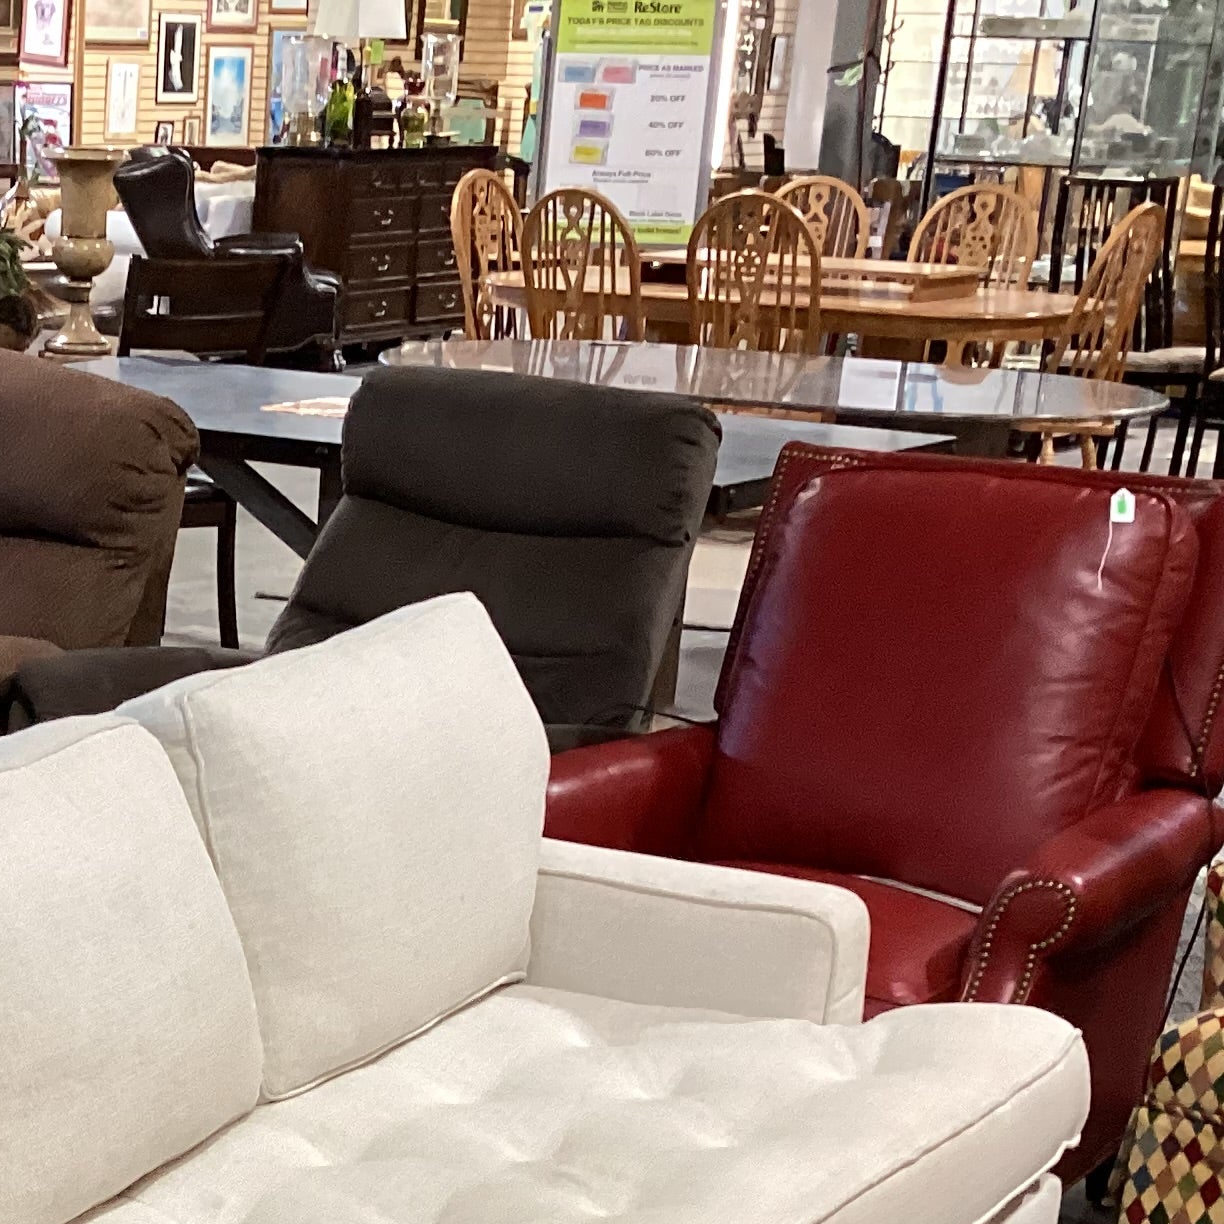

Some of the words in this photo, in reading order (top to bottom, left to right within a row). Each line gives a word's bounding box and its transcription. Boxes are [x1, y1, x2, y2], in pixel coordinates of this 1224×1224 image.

[634, 1, 682, 14] ReStore
[567, 16, 605, 25] TODAY'S
[606, 17, 631, 25] PRICE
[634, 17, 652, 26] TAG
[653, 17, 704, 26] DISCOUNTS
